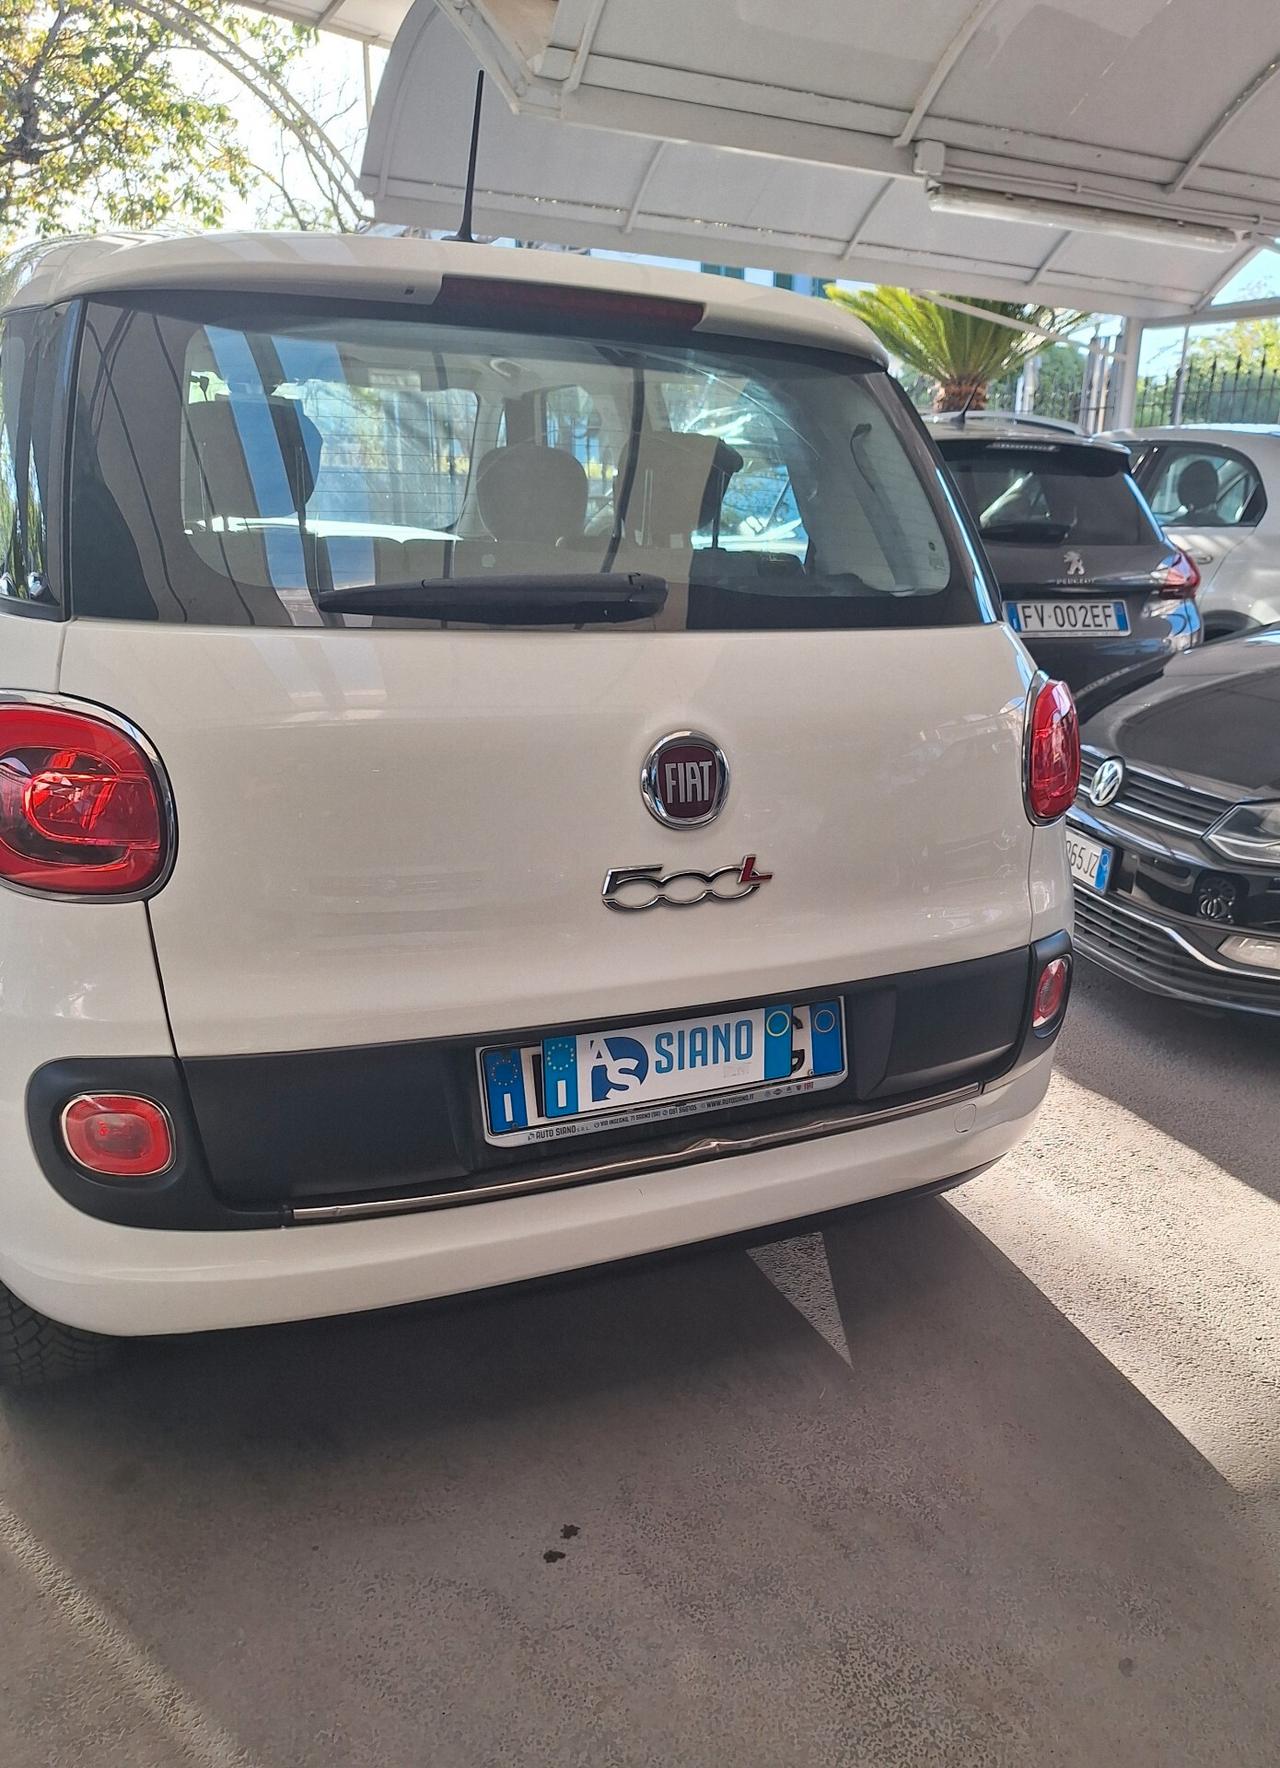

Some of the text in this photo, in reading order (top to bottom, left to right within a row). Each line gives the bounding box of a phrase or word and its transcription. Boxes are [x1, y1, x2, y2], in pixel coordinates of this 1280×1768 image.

[665, 760, 713, 804] FIAT
[601, 854, 773, 912] 500L
[655, 1019, 753, 1074] SIANO
[536, 1129, 554, 1139] AUTO
[555, 1125, 576, 1136] SIANO
